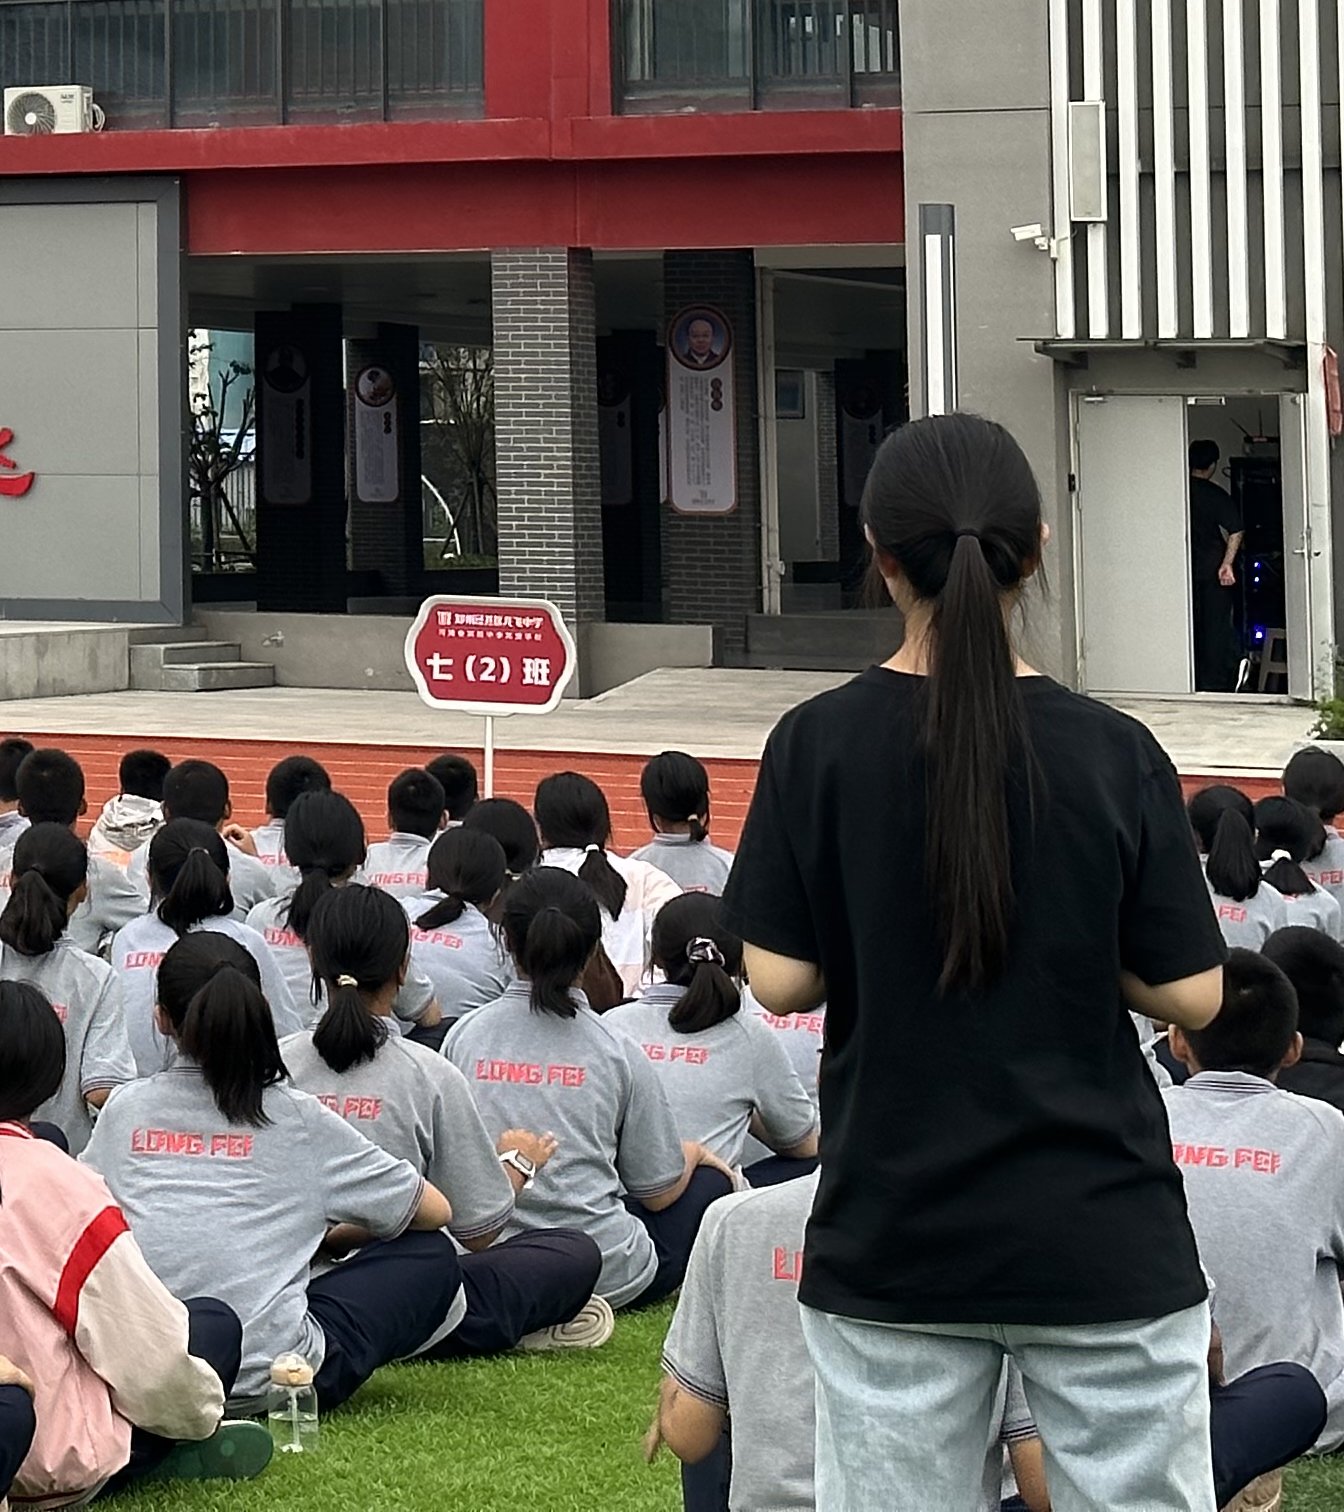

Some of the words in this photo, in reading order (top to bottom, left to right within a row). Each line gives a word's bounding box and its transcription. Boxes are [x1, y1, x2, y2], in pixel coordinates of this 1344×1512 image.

[475, 1059, 545, 1085] LONG
[546, 1064, 588, 1088] FEI
[131, 1127, 206, 1157] LONG
[207, 1133, 254, 1159] FEI
[1232, 1147, 1282, 1176] FEI
